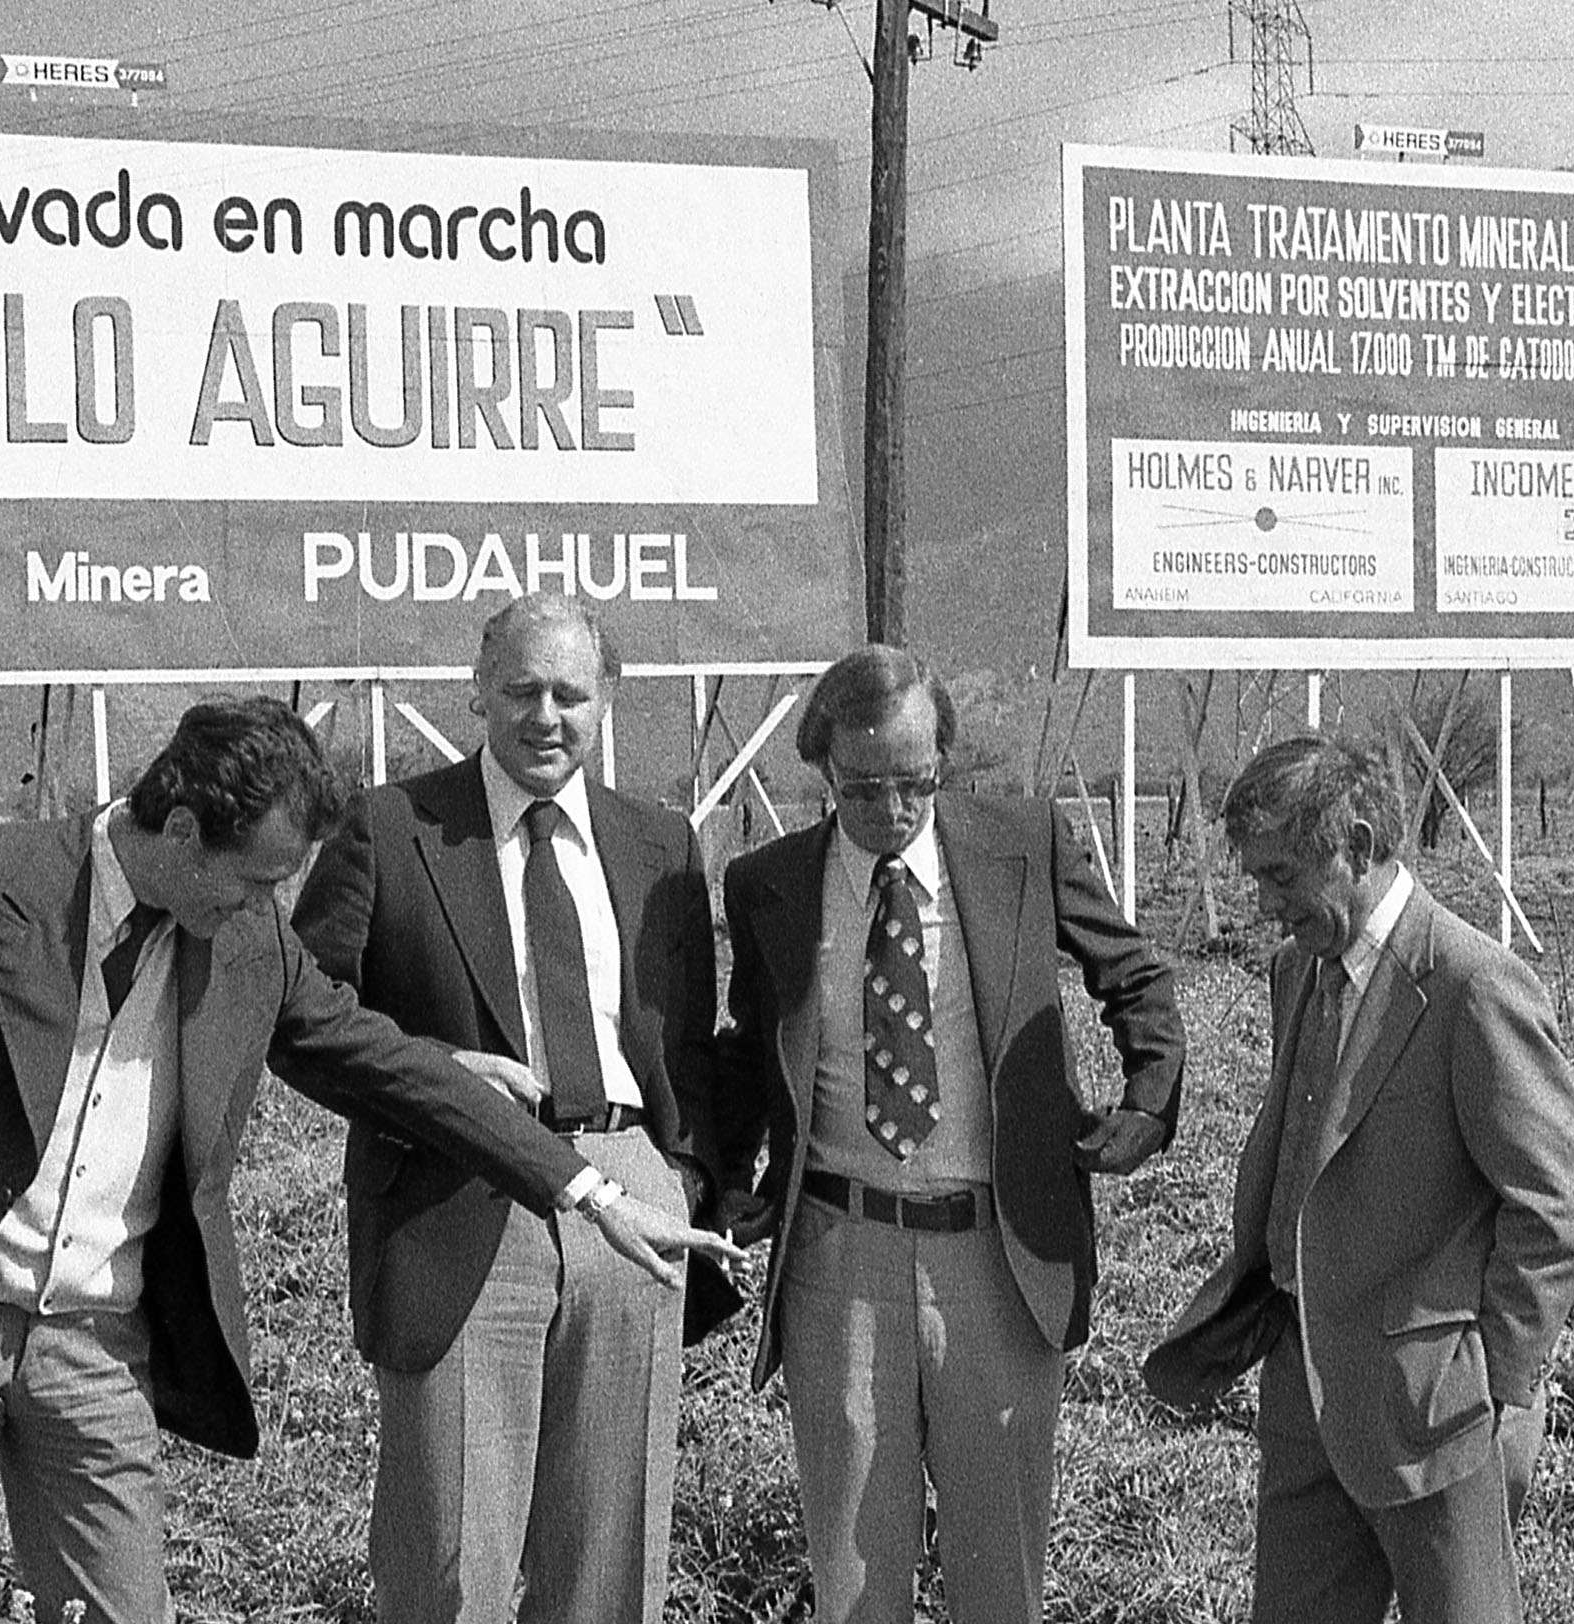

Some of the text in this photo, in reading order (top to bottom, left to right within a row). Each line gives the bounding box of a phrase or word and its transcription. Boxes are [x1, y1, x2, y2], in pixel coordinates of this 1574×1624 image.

[33, 62, 109, 83] HERES
[1383, 130, 1440, 150] HERES
[214, 187, 302, 254] en
[335, 187, 606, 265] marcha
[1109, 196, 1231, 256] PLANTA
[1247, 203, 1449, 266] TRATAMIENTO
[1110, 265, 1272, 315] EXTRACCION
[1280, 273, 1329, 317] POR
[1337, 276, 1470, 323] SOLVENTES
[1481, 282, 1502, 324] Y
[1121, 323, 1251, 371] PRODUCCION
[1262, 327, 1342, 374] ANUAL
[1351, 331, 1413, 376] 17.000
[1423, 334, 1456, 377] TM
[1466, 335, 1489, 378] DE
[1231, 409, 1322, 434] INGENIERIA
[1337, 413, 1352, 434] Y
[1368, 414, 1482, 439] SUPERVISION
[1495, 417, 1560, 441] GENERAL
[1128, 451, 1233, 491] HOLMES
[1269, 455, 1371, 495] NARVER
[1377, 475, 1404, 497] INC.
[27, 551, 211, 604] Minera
[304, 532, 719, 602] PUDAHUEL
[1152, 551, 1376, 576] ENGINEERS-CONSTRUCTORS
[1125, 586, 1403, 605] ANAHEIM CALIFORNIA
[1443, 590, 1518, 606] SANTIAGO
